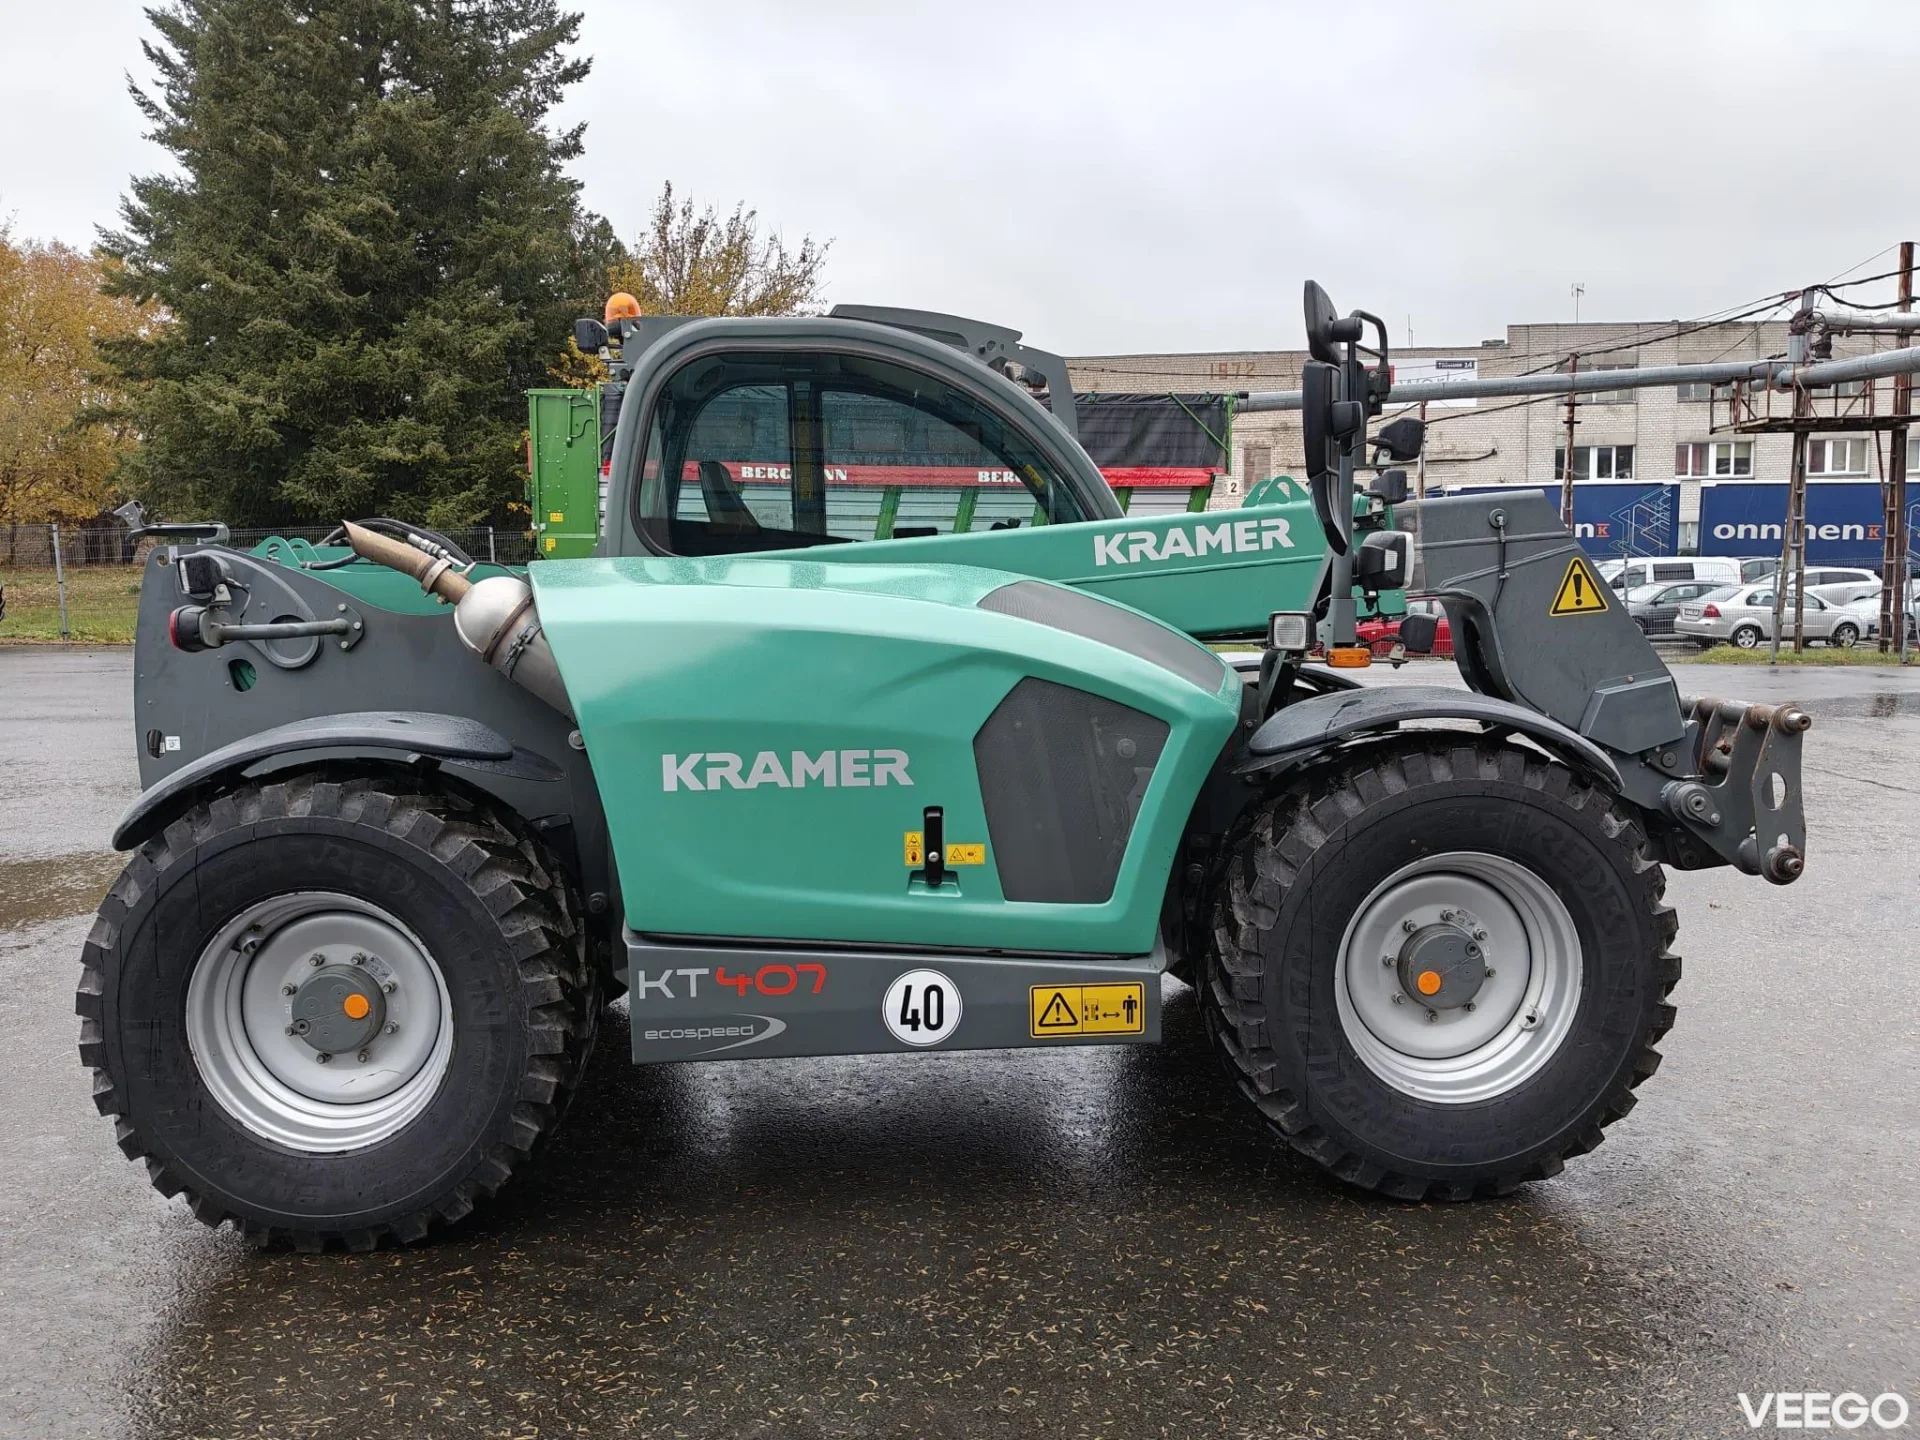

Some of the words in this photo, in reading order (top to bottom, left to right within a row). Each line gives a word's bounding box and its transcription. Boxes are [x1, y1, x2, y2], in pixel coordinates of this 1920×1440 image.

[1210, 361, 1256, 380] 1972
[1230, 482, 1237, 493] 2
[1093, 518, 1295, 566] KRAMER
[662, 749, 914, 792] KRAMER
[638, 968, 709, 999] KT
[715, 963, 826, 997] 407
[900, 984, 944, 1031] 40
[644, 1024, 754, 1040] ecospeed
